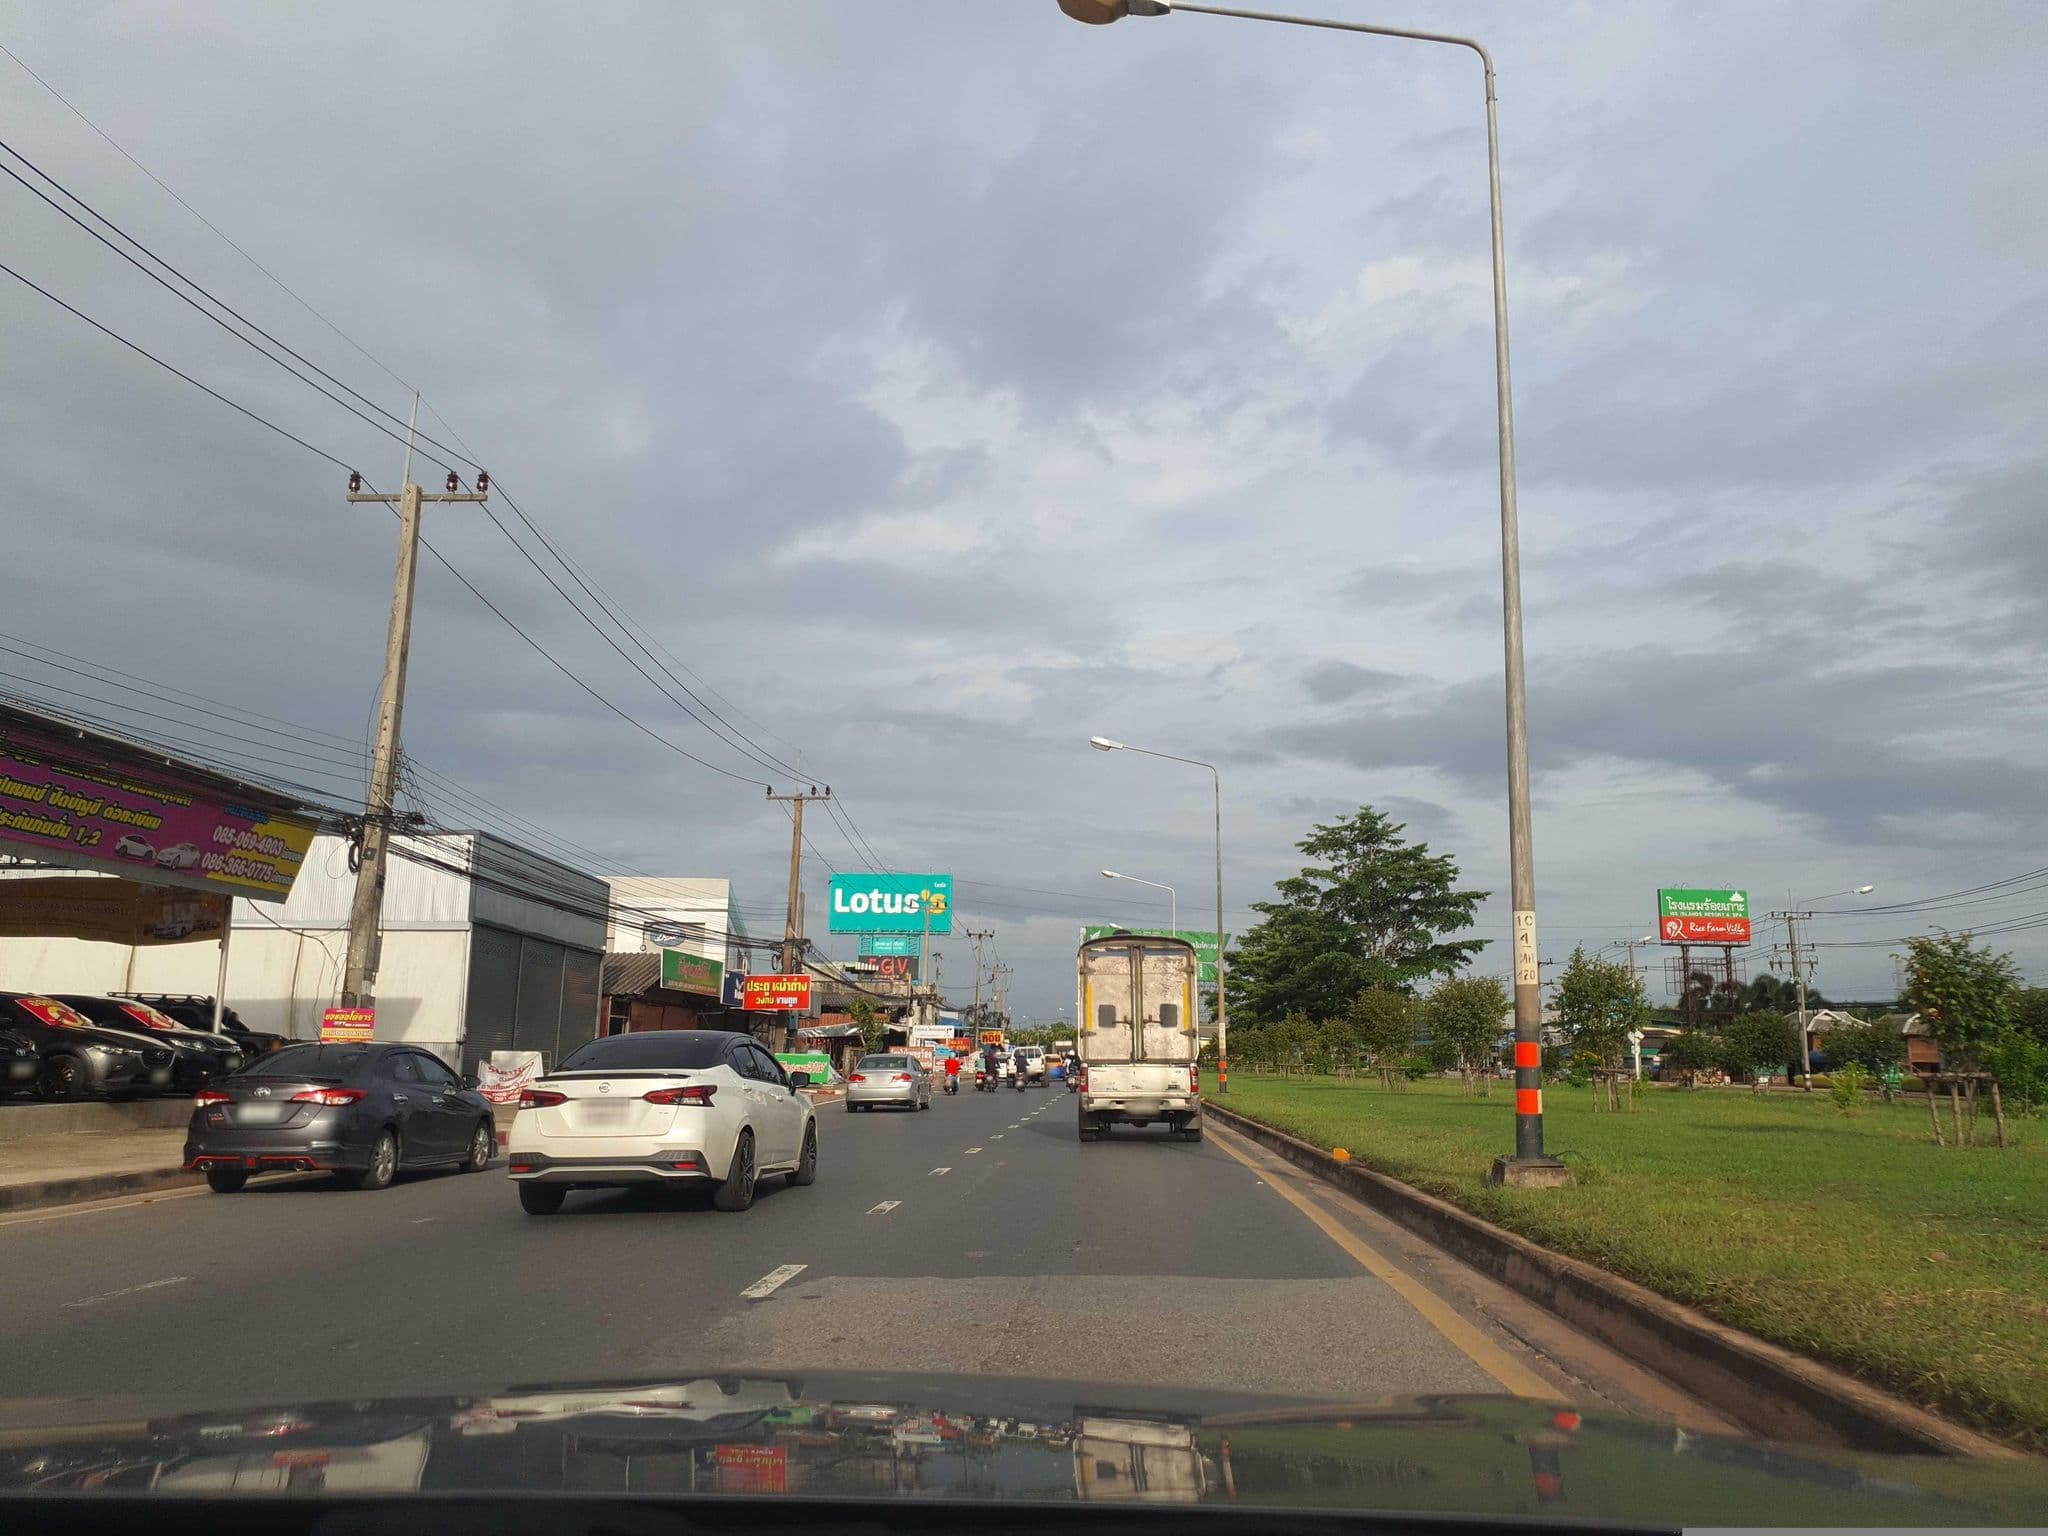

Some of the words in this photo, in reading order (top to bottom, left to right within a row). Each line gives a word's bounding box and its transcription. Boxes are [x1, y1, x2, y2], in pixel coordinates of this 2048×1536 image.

[201, 852, 275, 882] 086-366-0775
[834, 888, 947, 915] Lotus's
[1665, 896, 1745, 912] โรงแรมร้อยเกาะ
[746, 979, 770, 997] ประตู
